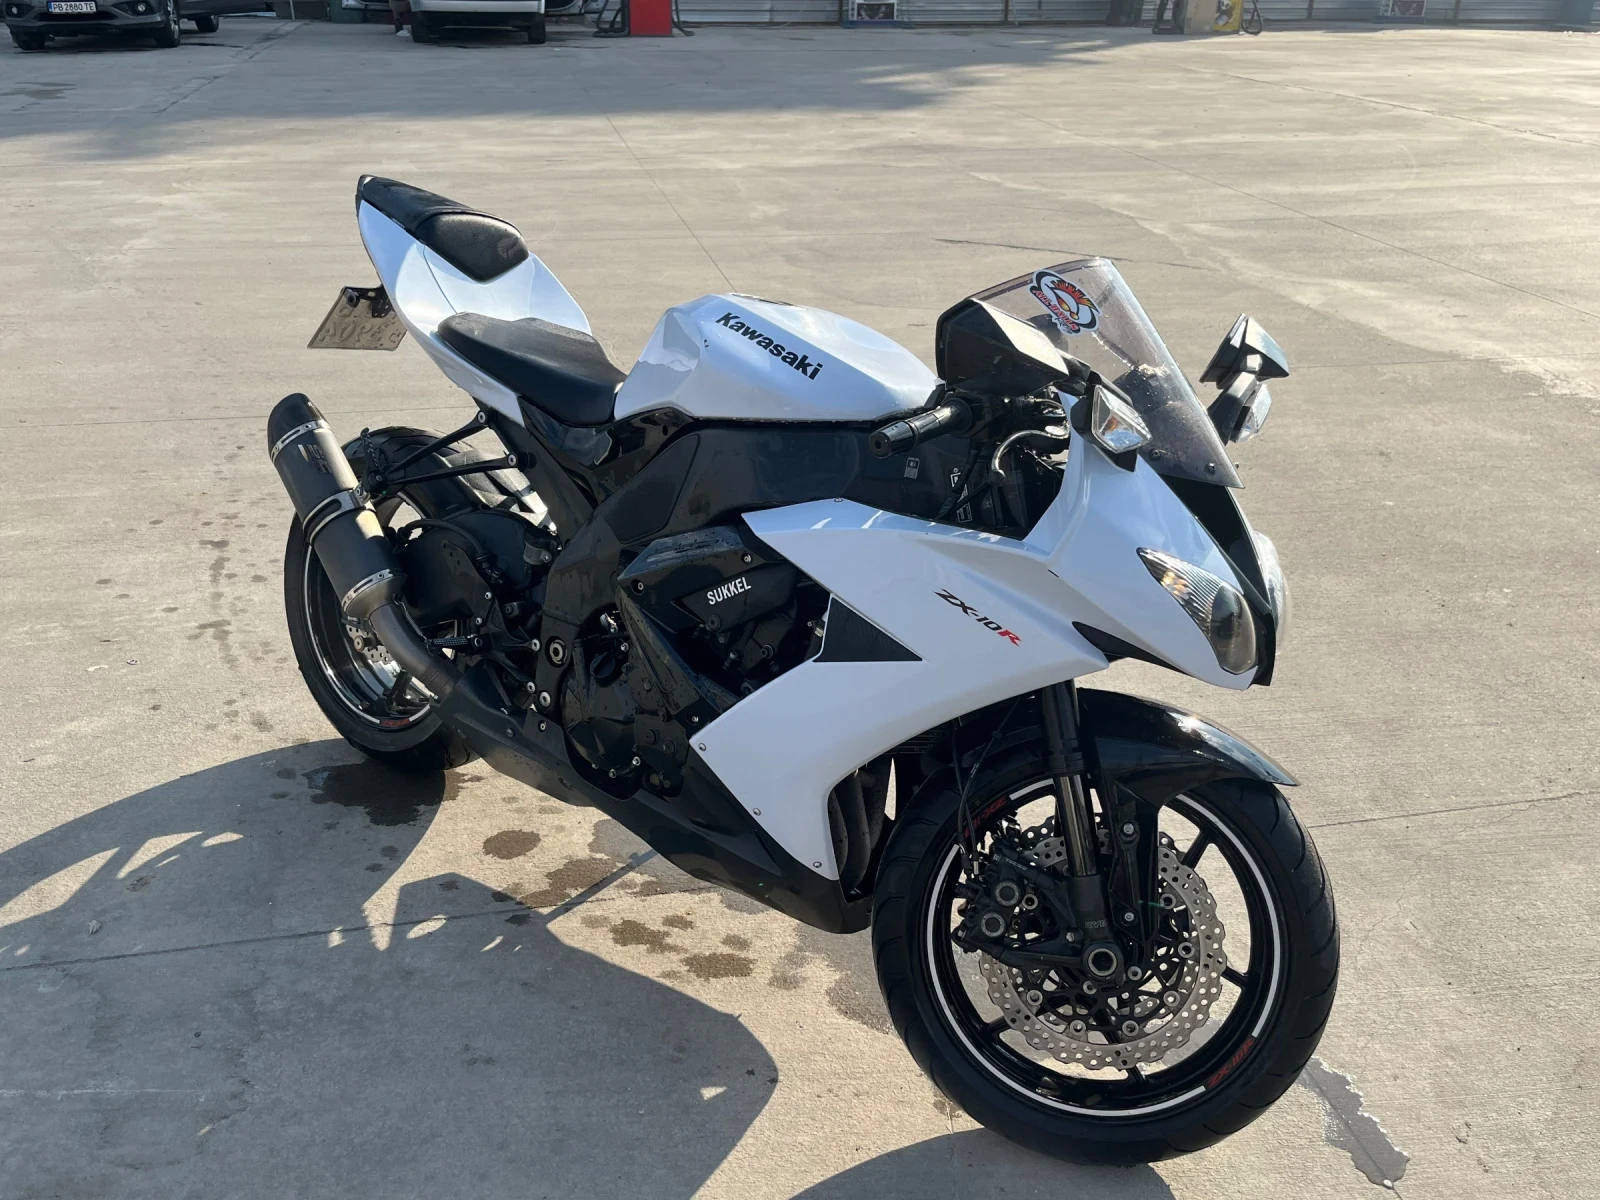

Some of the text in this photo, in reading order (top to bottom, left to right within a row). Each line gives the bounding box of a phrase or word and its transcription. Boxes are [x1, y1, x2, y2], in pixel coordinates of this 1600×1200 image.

[53, 2, 94, 11] PB 2880 TE
[715, 312, 823, 380] Kawasaki
[707, 576, 752, 605] SUKKEL
[933, 588, 1022, 647] ZX-10R
[1207, 1038, 1255, 1088] ZX-10R
